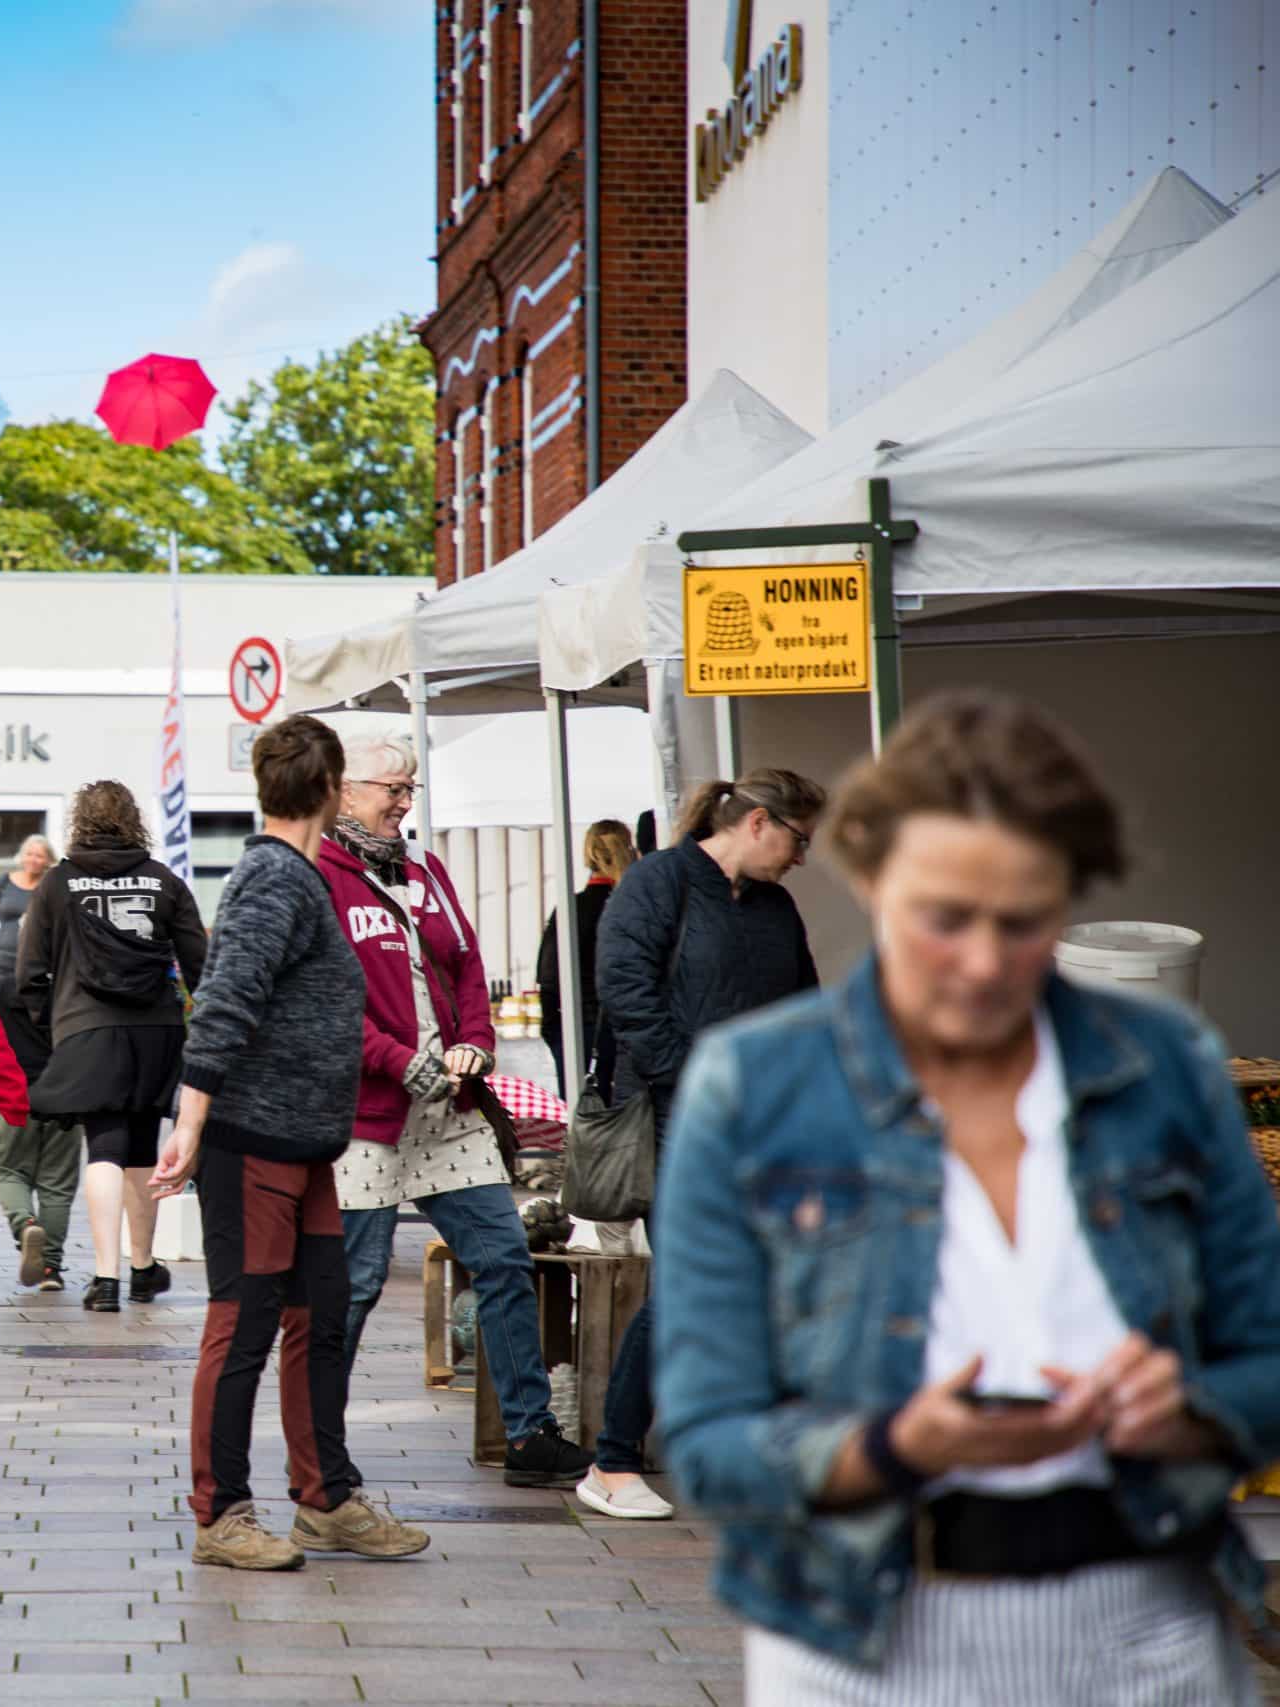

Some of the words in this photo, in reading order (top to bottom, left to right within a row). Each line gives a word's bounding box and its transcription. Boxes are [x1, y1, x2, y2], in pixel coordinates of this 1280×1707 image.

[764, 576, 858, 603] HONNING
[801, 615, 820, 629] fra
[775, 637, 805, 650] egen
[699, 664, 714, 681] Et
[718, 663, 751, 681] rent
[754, 659, 858, 682] naturprodukt
[80, 895, 155, 941] 15
